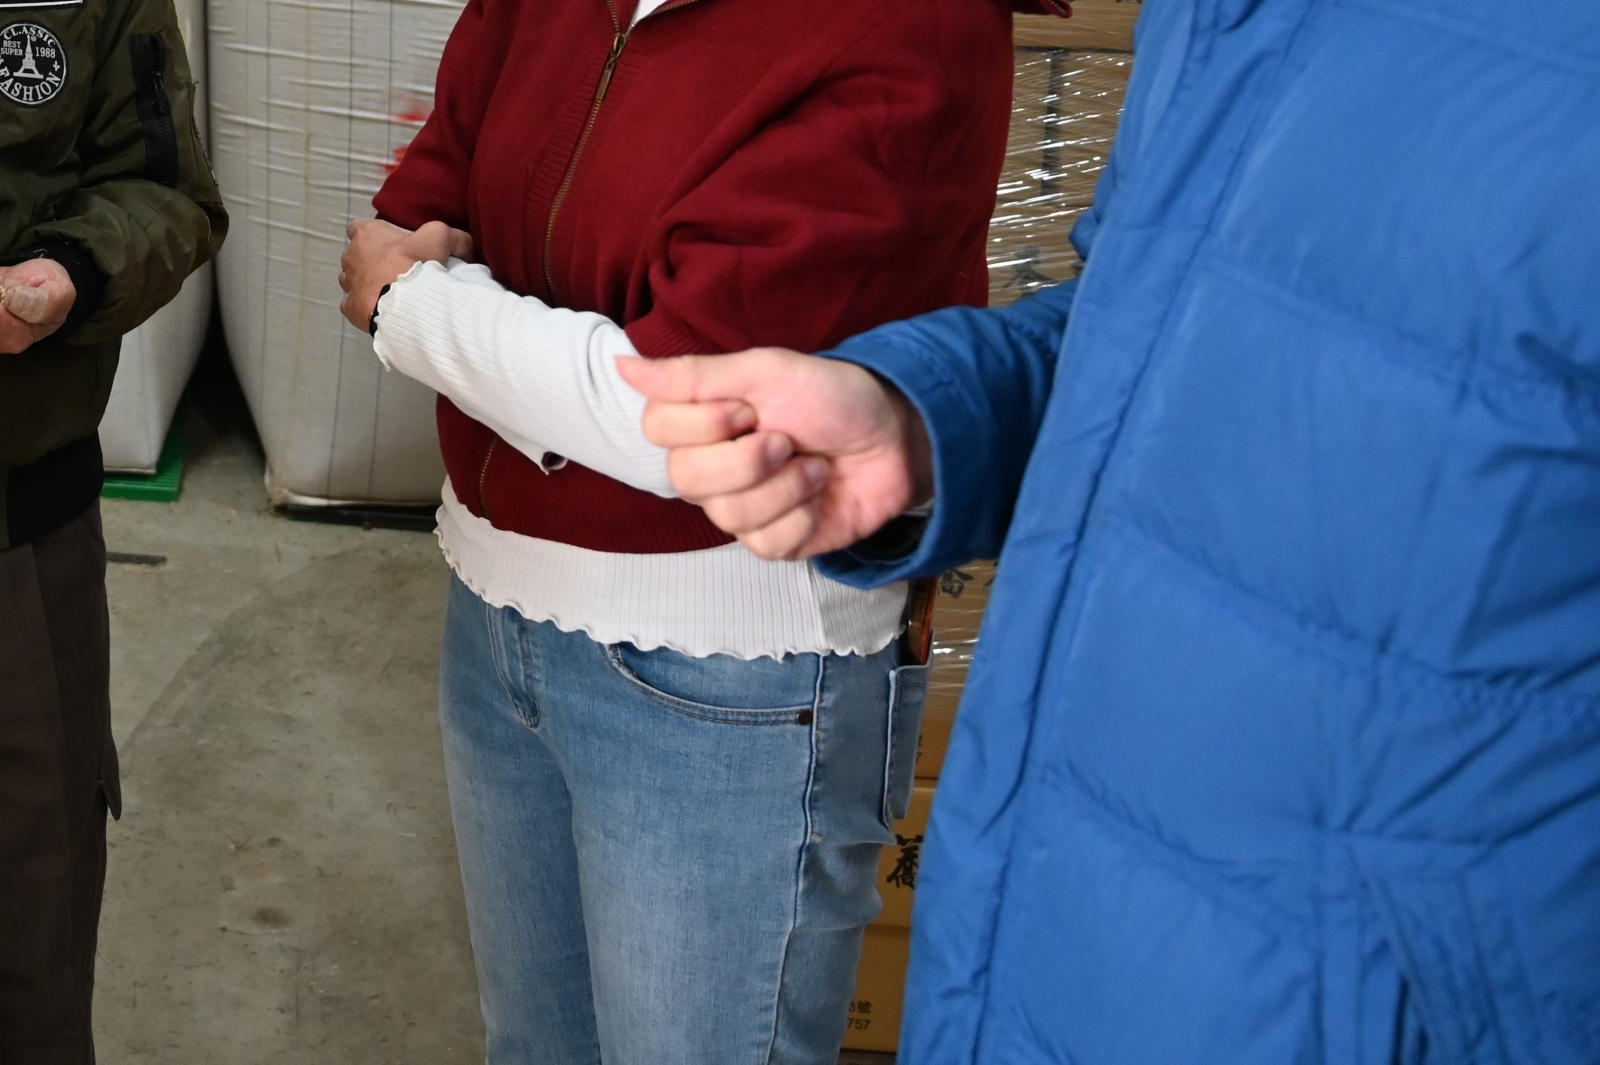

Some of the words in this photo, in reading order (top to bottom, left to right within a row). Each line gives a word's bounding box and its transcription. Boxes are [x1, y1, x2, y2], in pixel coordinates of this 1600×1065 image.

[3, 40, 21, 48] BEST
[0, 47, 23, 56] SUPER
[35, 46, 56, 58] 1988
